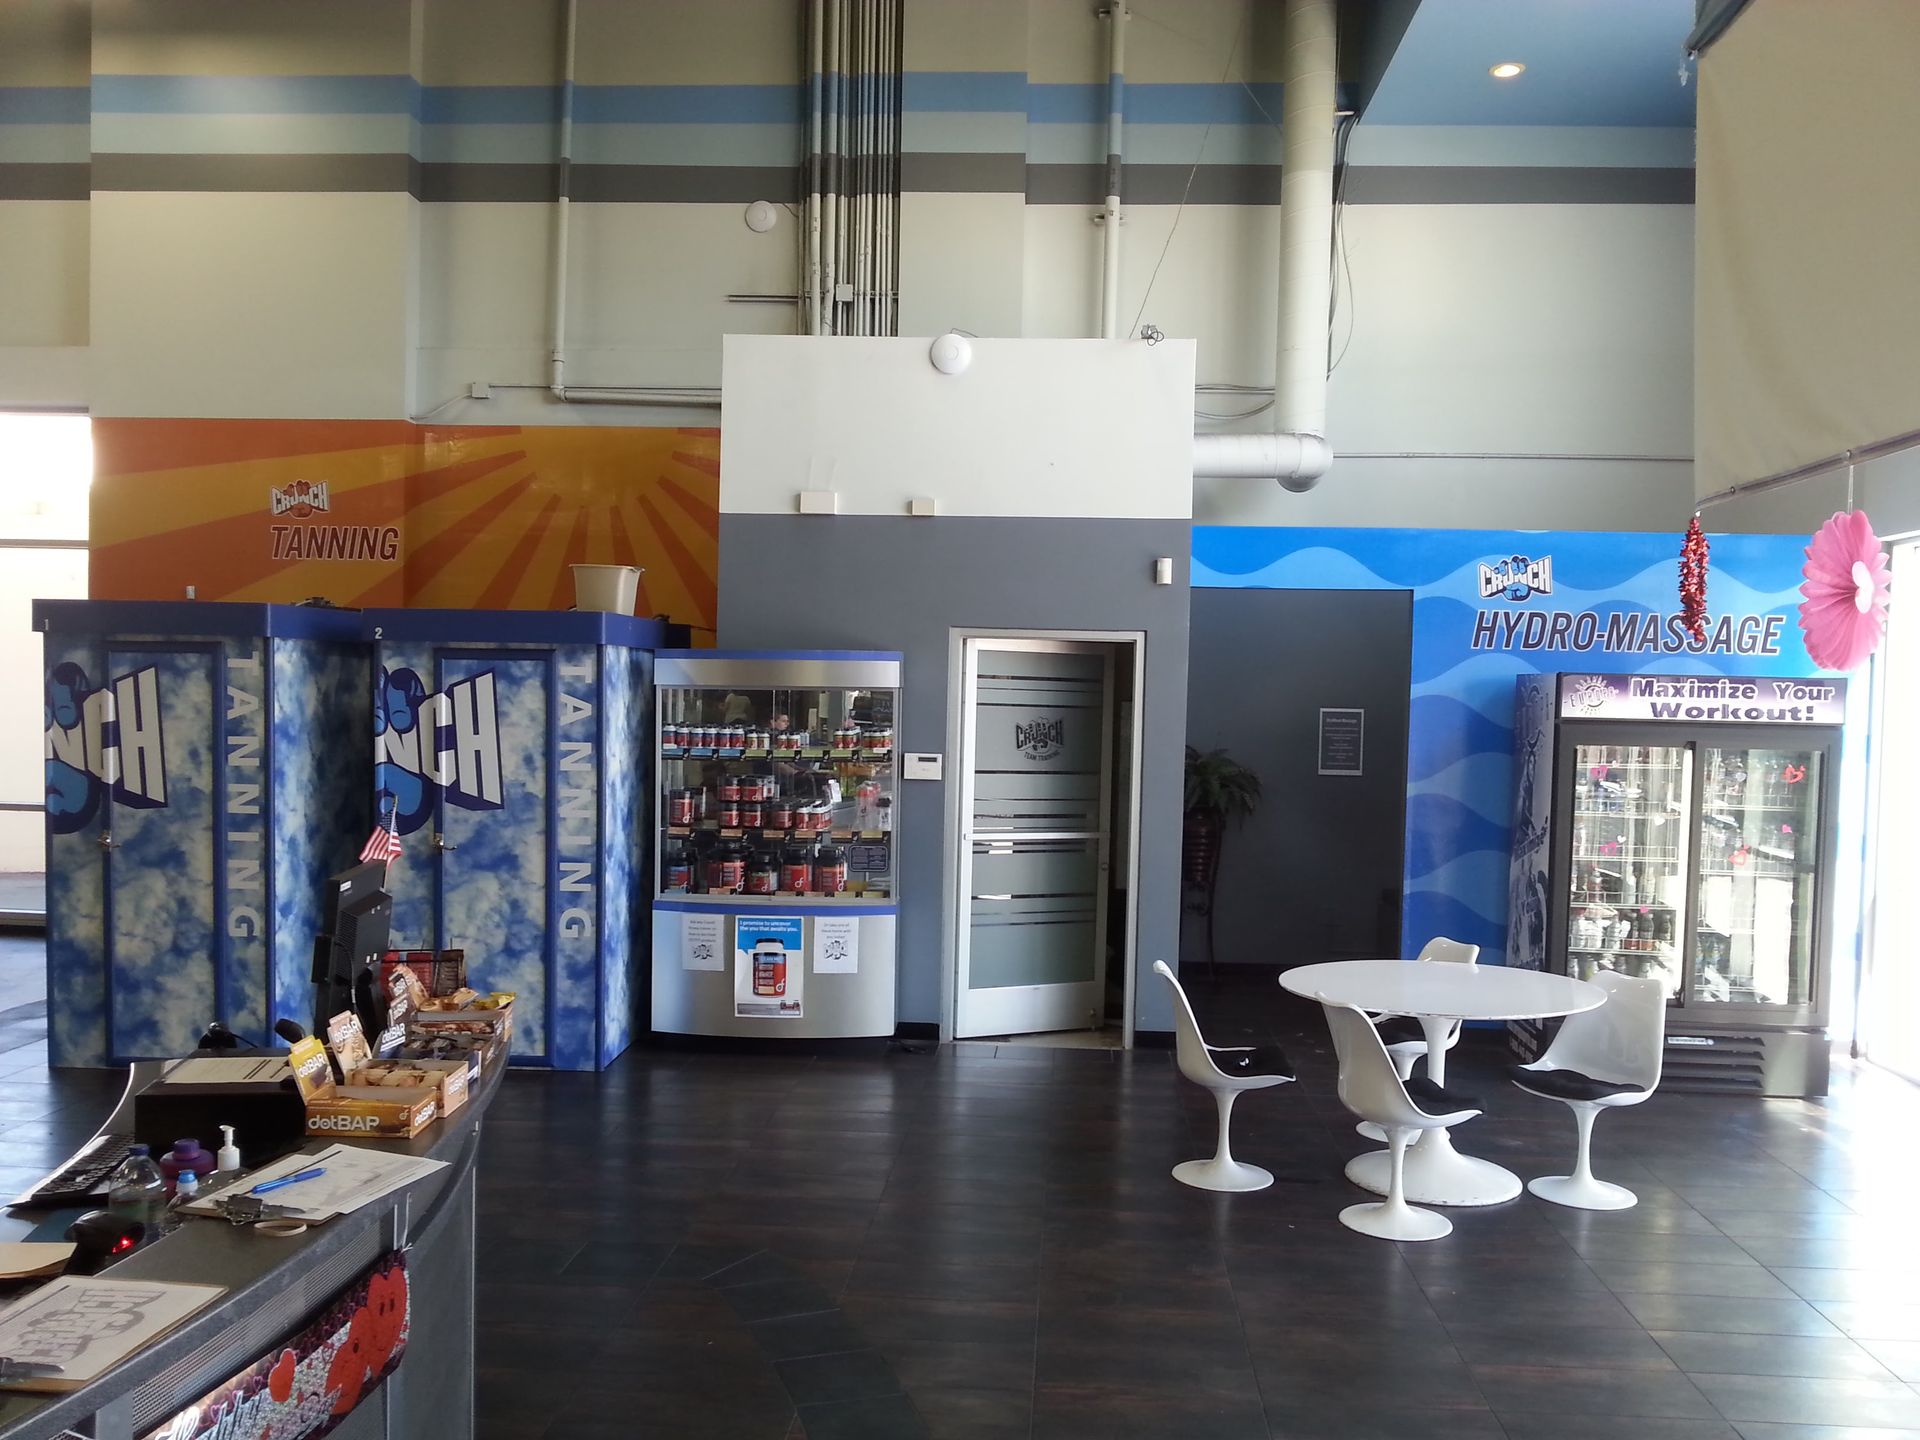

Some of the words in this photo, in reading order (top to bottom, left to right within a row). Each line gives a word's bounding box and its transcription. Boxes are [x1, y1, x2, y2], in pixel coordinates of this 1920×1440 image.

[271, 481, 328, 515] CRUNCH
[271, 525, 399, 560] TANNING
[1478, 555, 1552, 599] CRUNCH
[374, 627, 382, 639] 2
[1631, 678, 1758, 701] Maximize
[1774, 683, 1834, 702] Your
[1650, 702, 1814, 721] Workout!
[1016, 720, 1063, 749] CRUNCH
[227, 651, 260, 937] TANNING
[559, 658, 594, 939] TANNING
